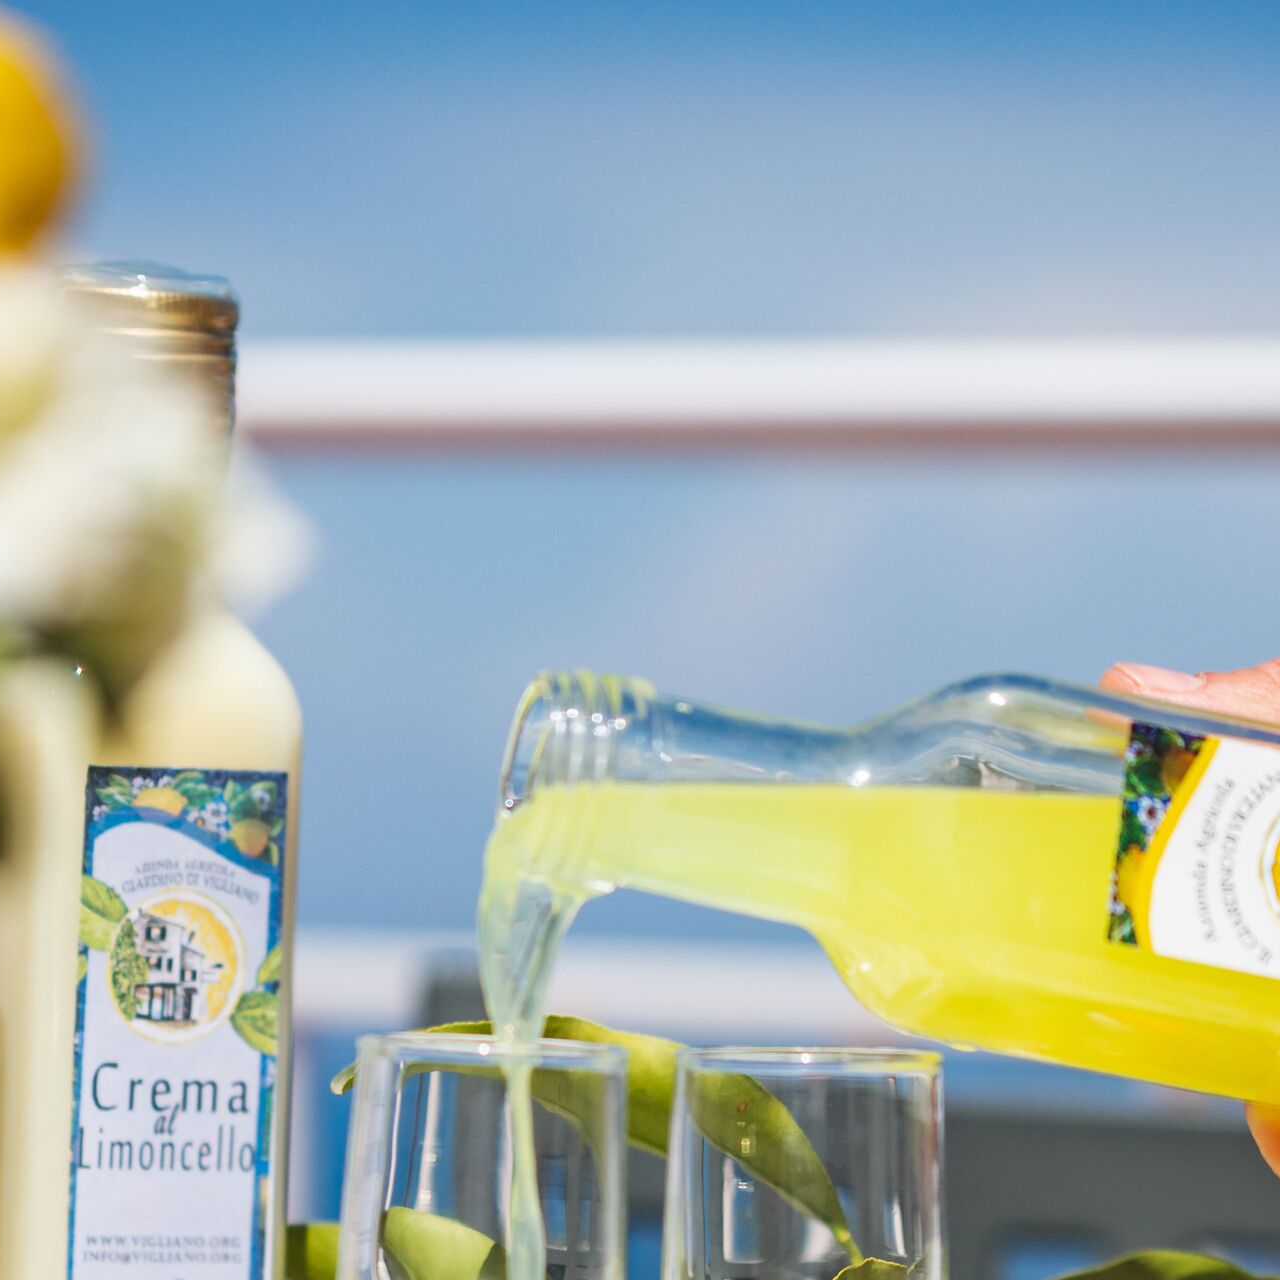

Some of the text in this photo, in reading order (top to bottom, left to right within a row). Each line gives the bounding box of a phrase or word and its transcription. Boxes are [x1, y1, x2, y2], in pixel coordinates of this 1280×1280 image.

[186, 873, 199, 886] DI
[91, 1062, 248, 1114] Crema
[153, 1103, 180, 1135] al
[78, 1124, 257, 1173] Limoncello
